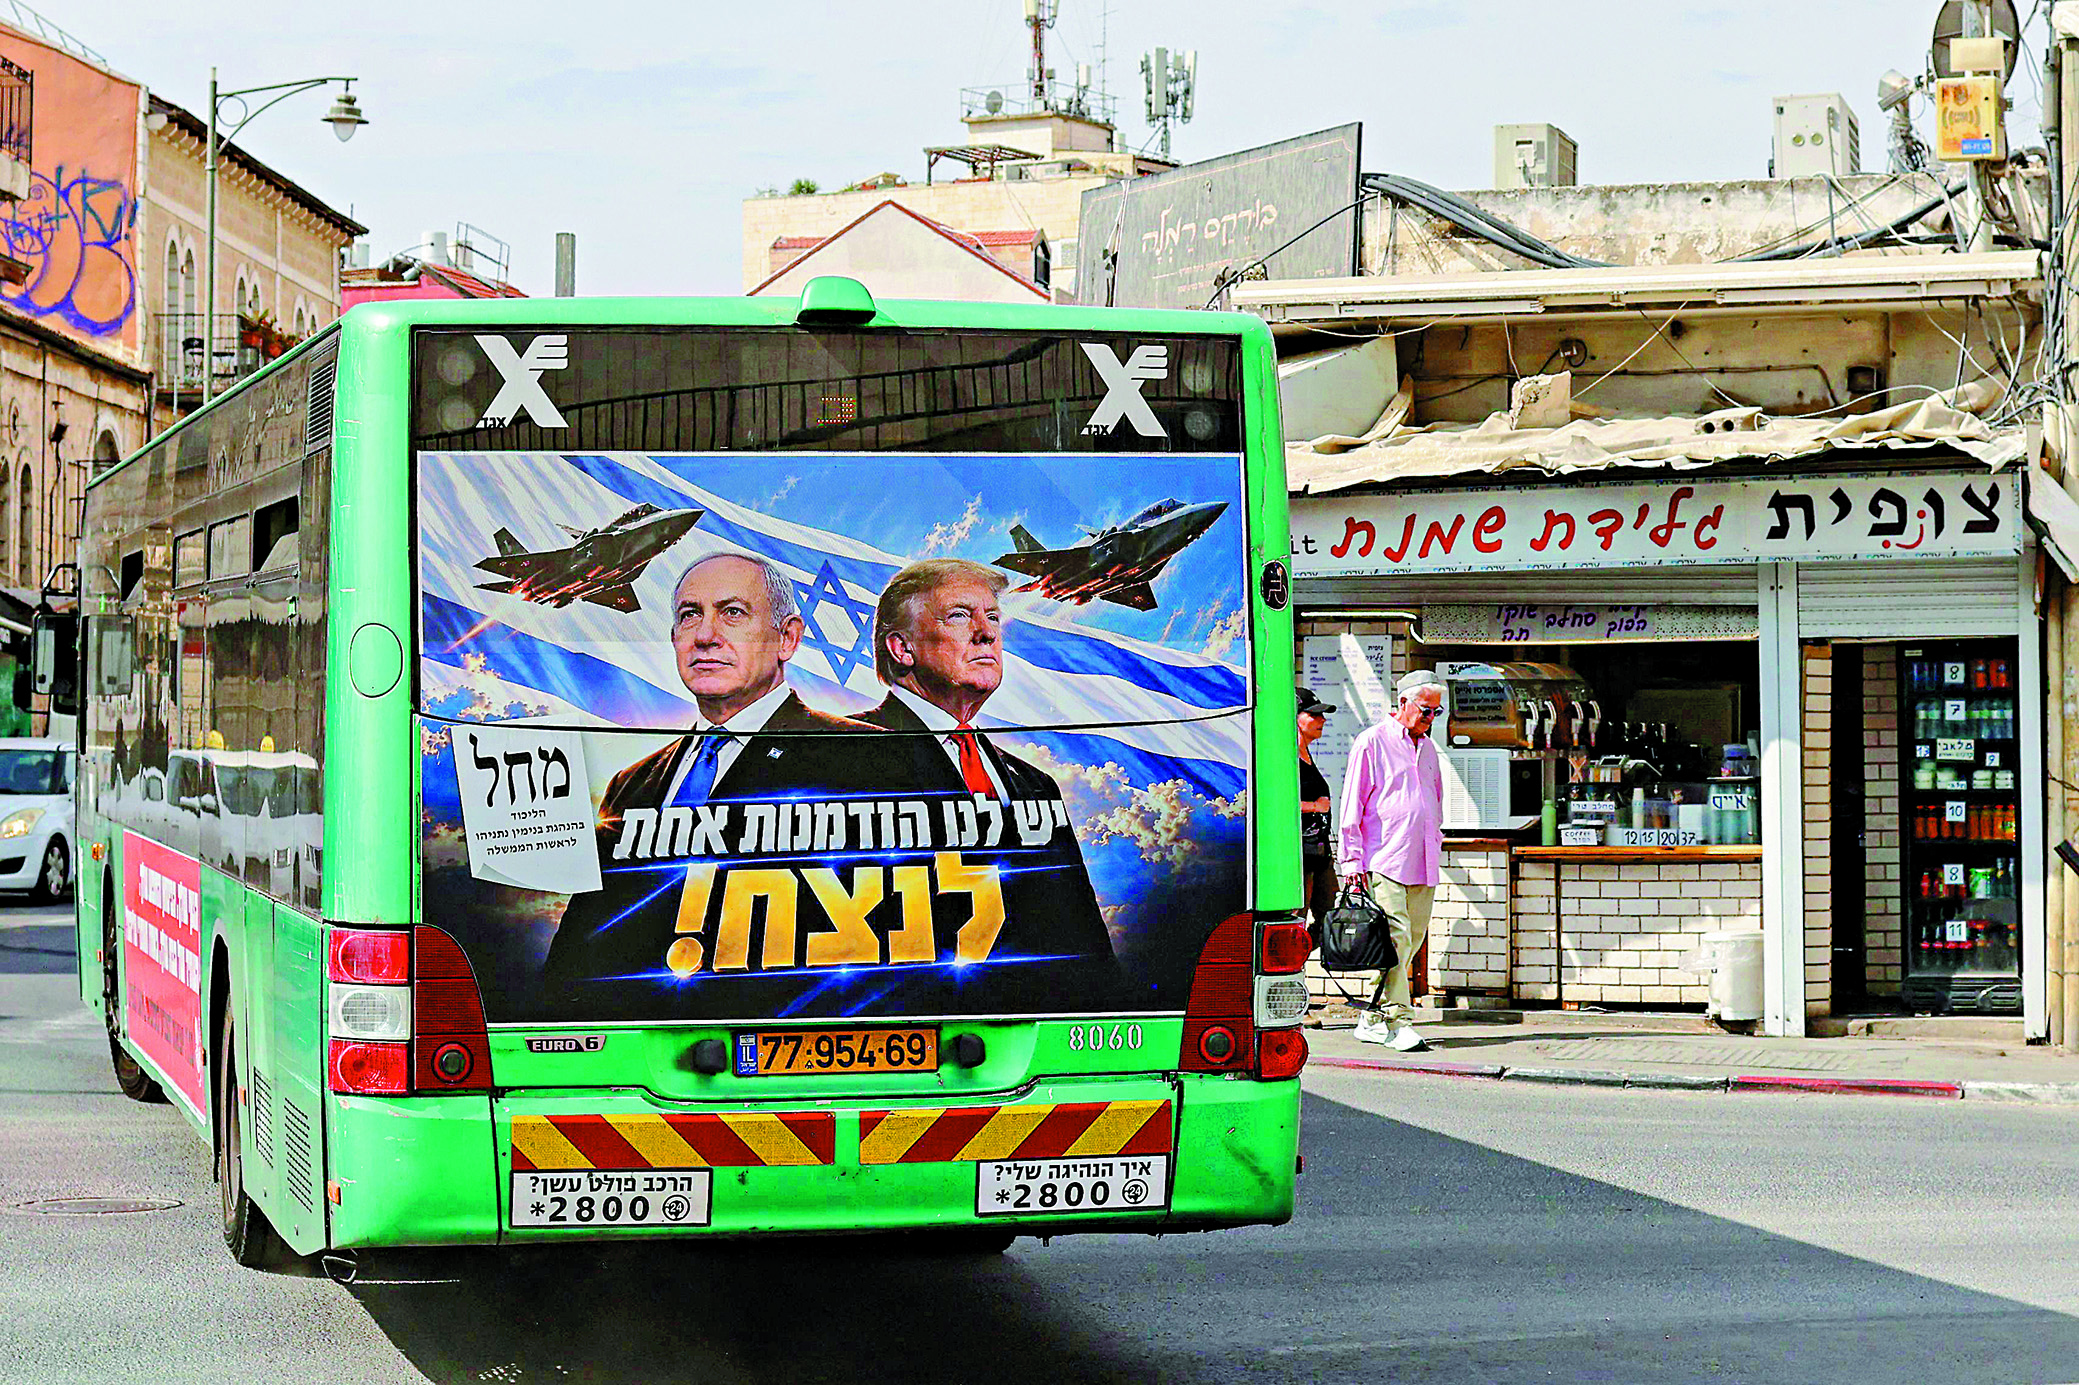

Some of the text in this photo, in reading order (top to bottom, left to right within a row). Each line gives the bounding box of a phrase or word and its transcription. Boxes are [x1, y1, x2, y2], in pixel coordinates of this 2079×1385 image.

[1329, 485, 1725, 564] גלידת שמנת
[1545, 605, 1597, 628] סחלב
[1502, 627, 1530, 642] תה
[1950, 665, 1960, 680] 8
[1950, 704, 1960, 716] 7
[1988, 754, 1996, 766] 9
[468, 732, 571, 808] מחל
[1712, 795, 1747, 810] אייס
[511, 809, 546, 821] הליכוד
[1948, 805, 1963, 817] 10
[475, 821, 585, 841] בהנהגת בנימין נתניהו
[611, 793, 1069, 860] יש לנו הזדמנות אחת
[1624, 831, 1638, 845] 12
[1641, 831, 1655, 843] 15
[1661, 831, 1677, 846] 20
[1681, 832, 1696, 846] 37
[487, 837, 577, 856] לראשות הממשלה
[1949, 866, 1959, 881] 8
[665, 850, 1006, 977] לנצח!
[1948, 924, 1963, 937] 11
[532, 1036, 599, 1051] EURO 6
[1069, 1024, 1143, 1051] 8060
[741, 1046, 754, 1062] IL
[994, 1161, 1152, 1182] איך הנהיגה שלי?
[529, 1175, 693, 1196] הרכב פולט עשן?
